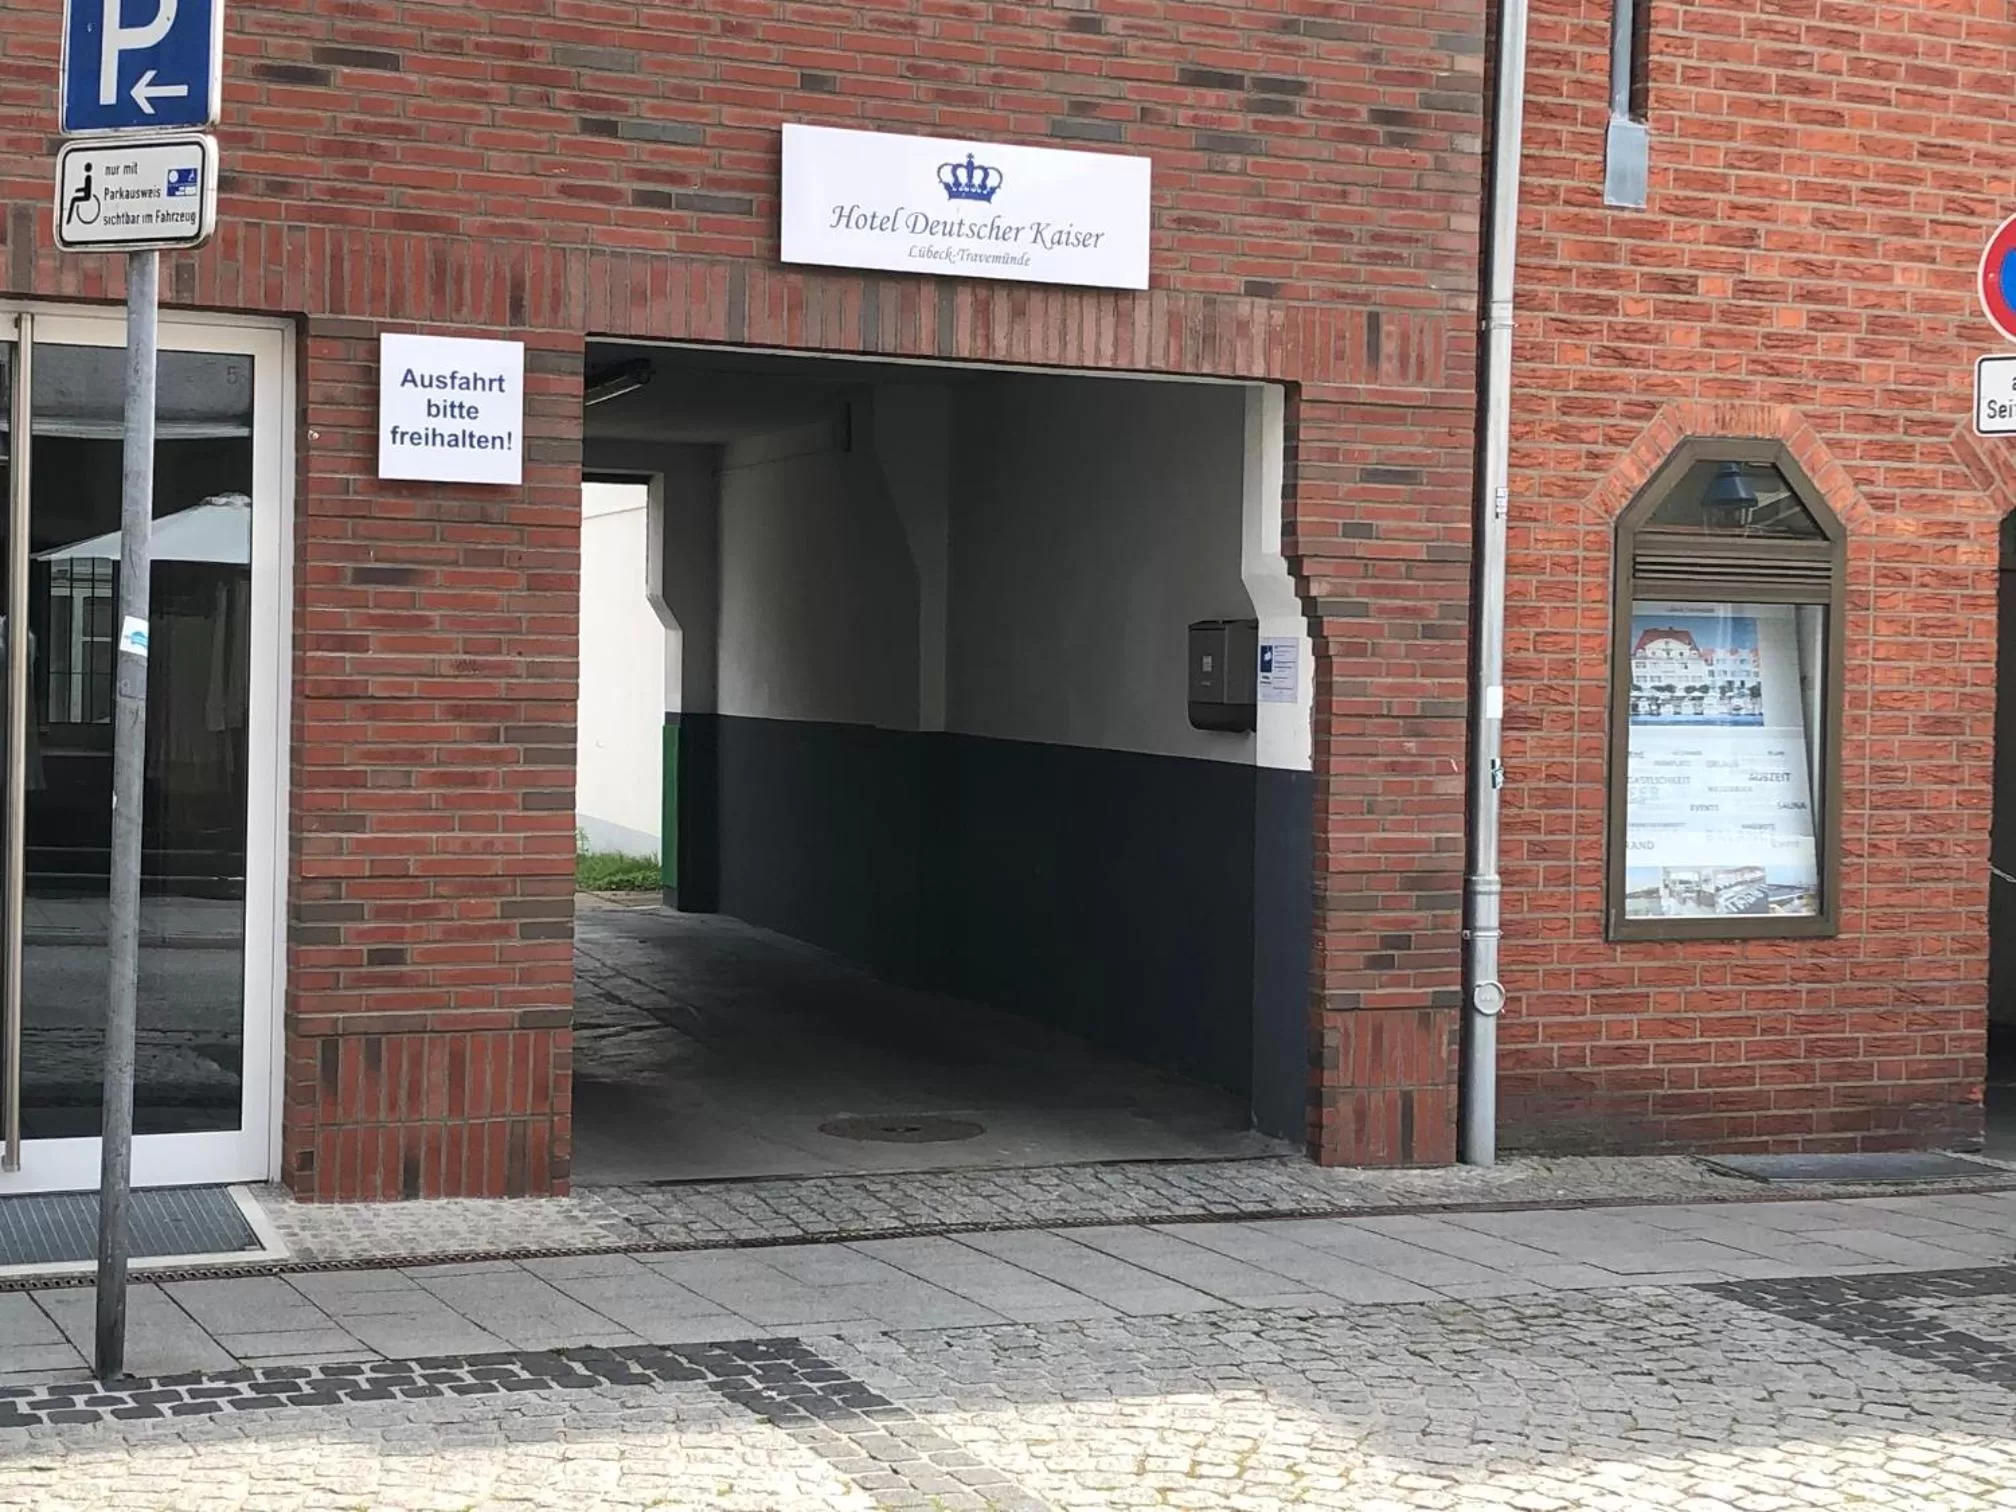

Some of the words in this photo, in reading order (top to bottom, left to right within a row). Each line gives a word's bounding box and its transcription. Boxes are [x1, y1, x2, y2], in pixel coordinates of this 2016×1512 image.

[99, 0, 178, 106] P
[104, 165, 120, 176] nur
[123, 162, 138, 175] mit
[104, 185, 161, 201] Parkausweis
[103, 212, 140, 226] sichtbar
[141, 212, 153, 224] im
[155, 209, 196, 225] Fahrzeug
[829, 204, 904, 233] Hotel
[905, 211, 1024, 243] Deutscher
[1030, 221, 1105, 250] Kaiser
[400, 367, 506, 393] Ausfahrt
[426, 398, 480, 420] bitte
[390, 425, 513, 451] freihalten!
